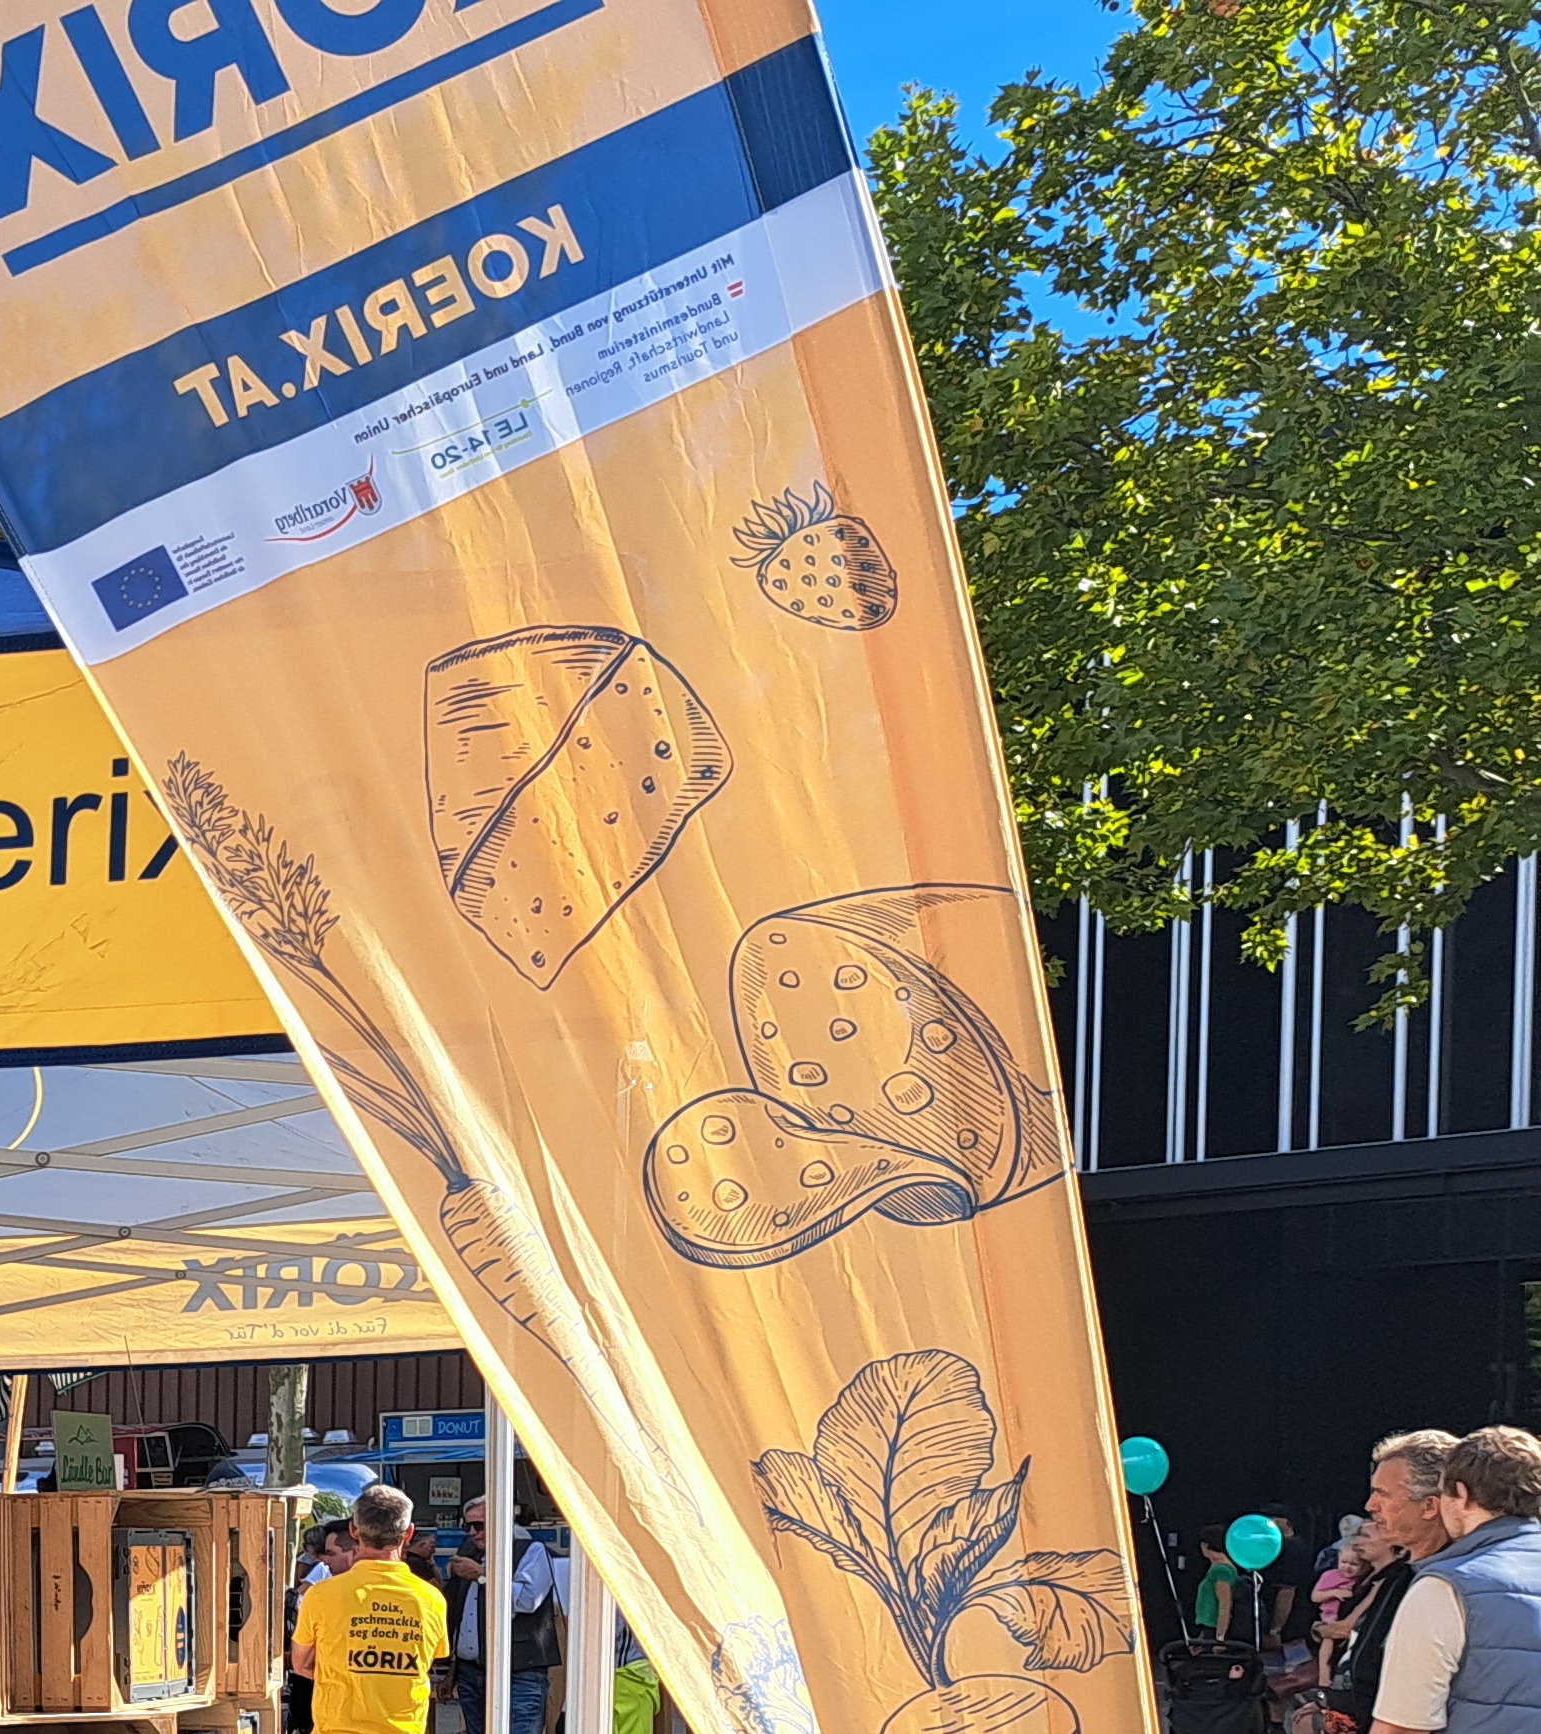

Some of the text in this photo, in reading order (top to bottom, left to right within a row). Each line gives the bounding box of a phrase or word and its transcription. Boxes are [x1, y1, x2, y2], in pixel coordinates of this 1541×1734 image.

[437, 1418, 482, 1435] DONUT
[349, 1629, 369, 1640] seg
[371, 1627, 399, 1639] doch
